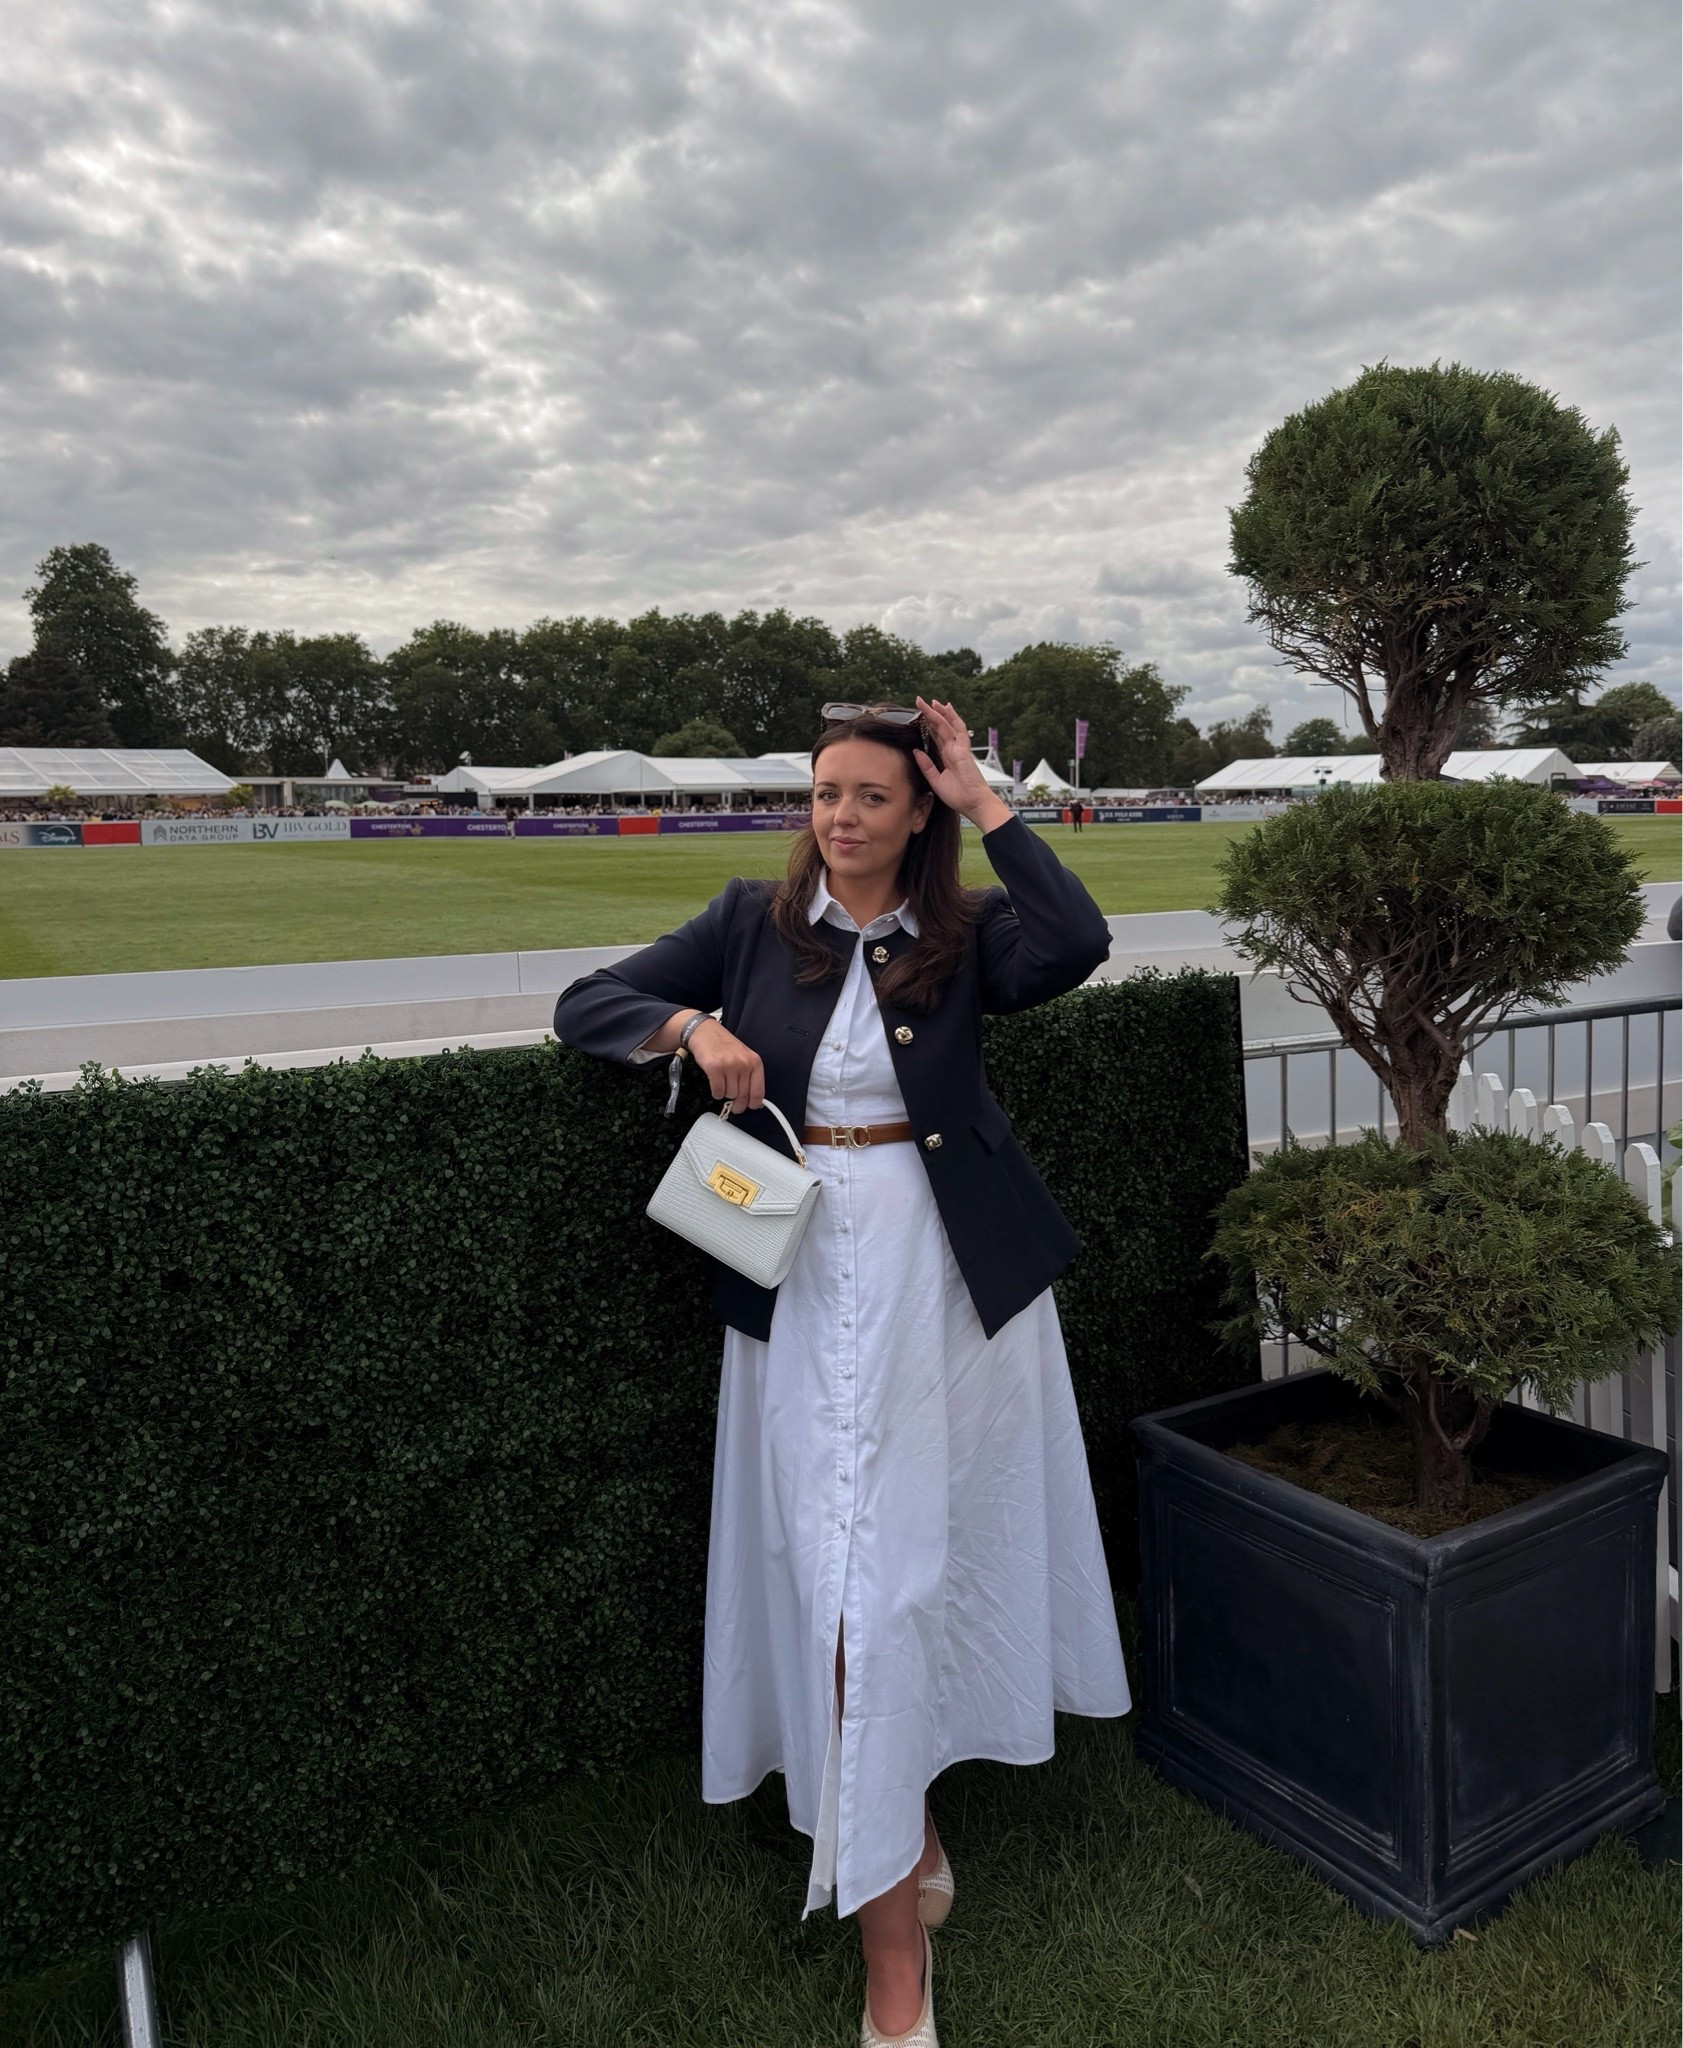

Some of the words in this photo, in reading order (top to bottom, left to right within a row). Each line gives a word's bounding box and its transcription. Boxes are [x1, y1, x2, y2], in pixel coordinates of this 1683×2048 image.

[170, 825, 238, 835] NORTHERN
[284, 822, 305, 832] IBV
[308, 821, 347, 832] GOLD
[170, 834, 197, 842] DATA
[202, 833, 239, 841] GROUP
